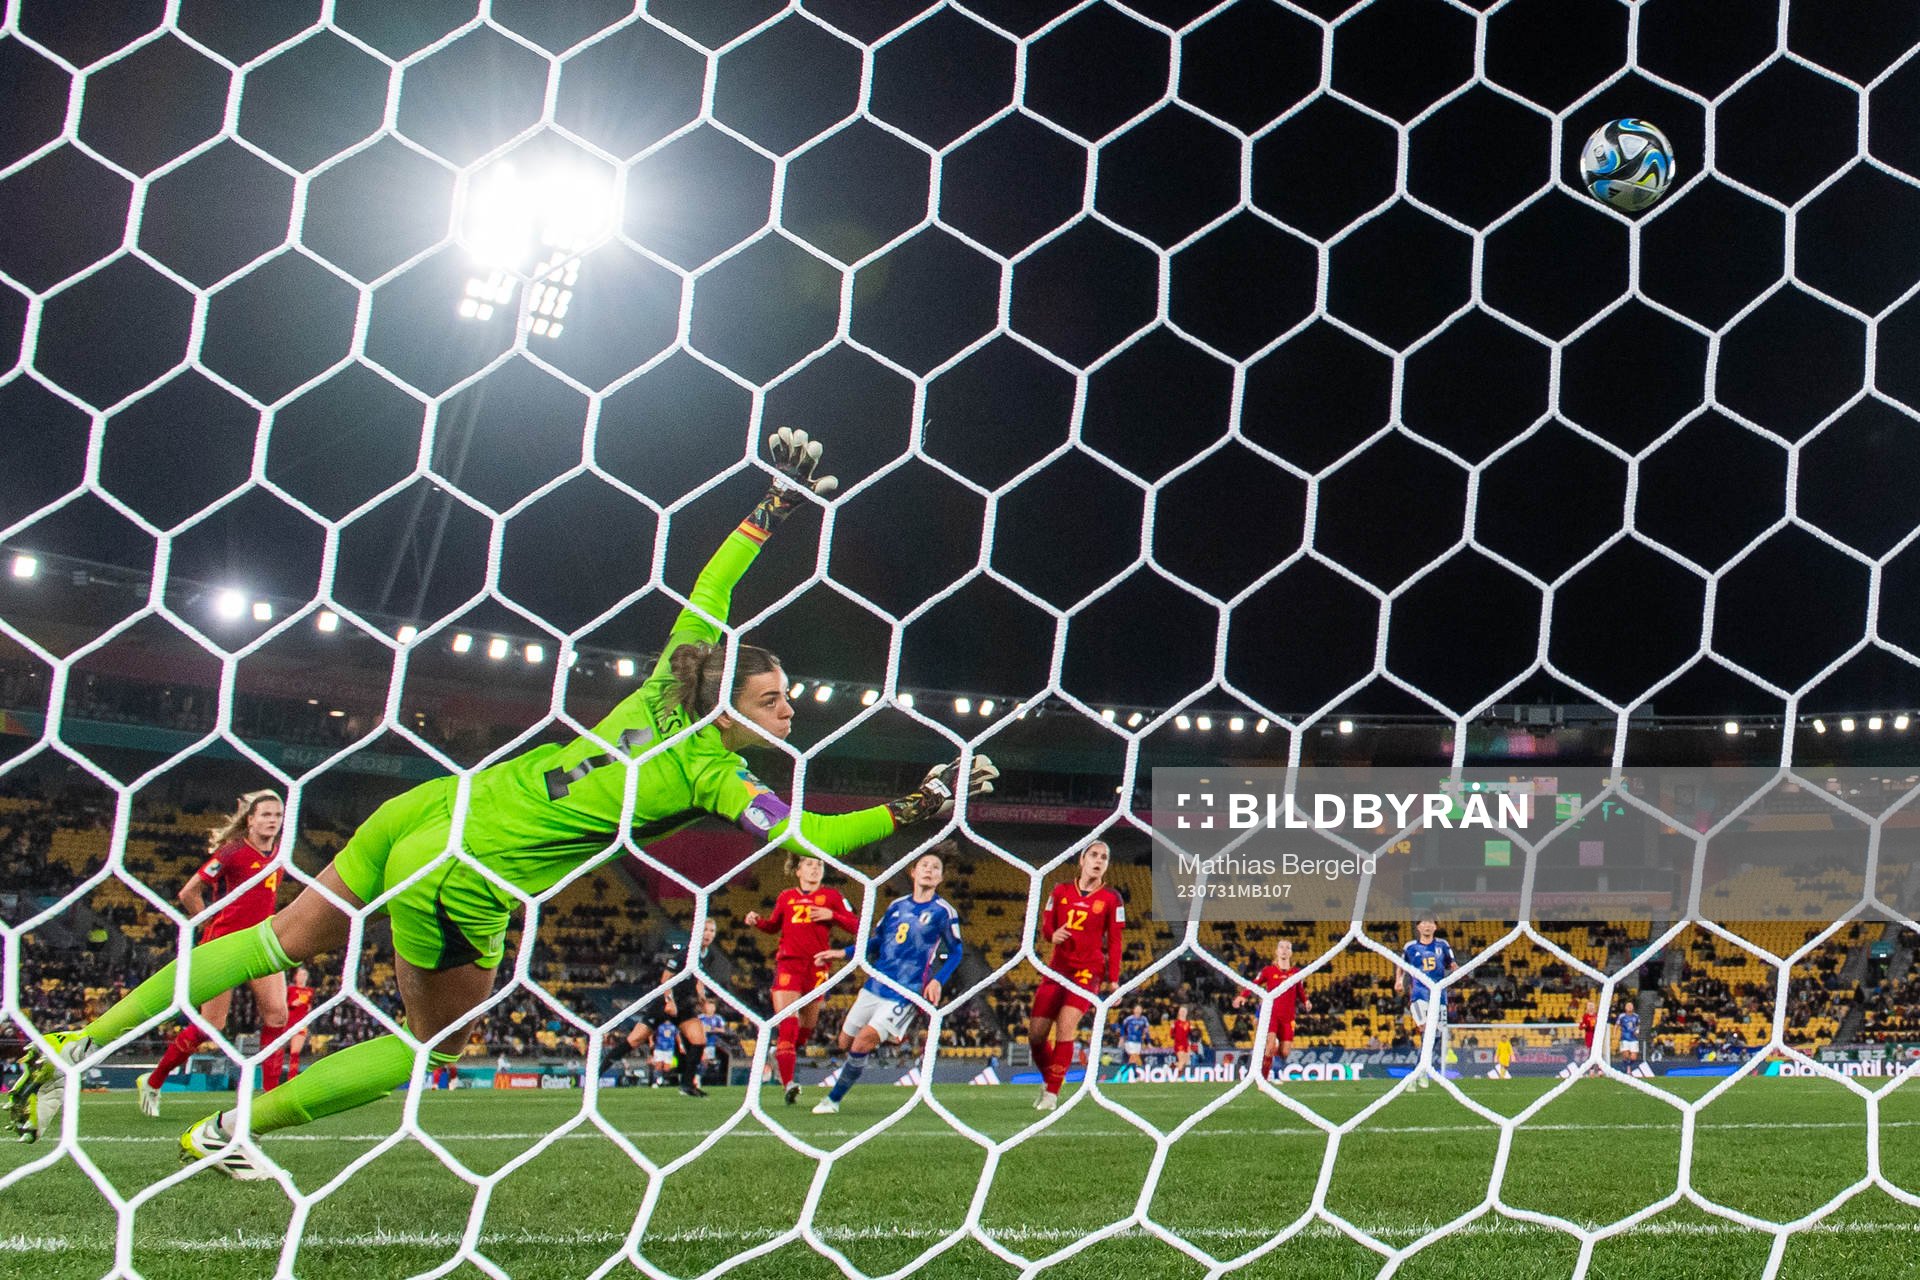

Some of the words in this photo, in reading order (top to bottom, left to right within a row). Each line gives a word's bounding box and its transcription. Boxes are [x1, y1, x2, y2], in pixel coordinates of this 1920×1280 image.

[265, 871, 277, 892] 4
[1067, 909, 1088, 931] 12
[895, 922, 909, 944] 8
[1423, 957, 1436, 971] 15
[1185, 1063, 1235, 1082] until
